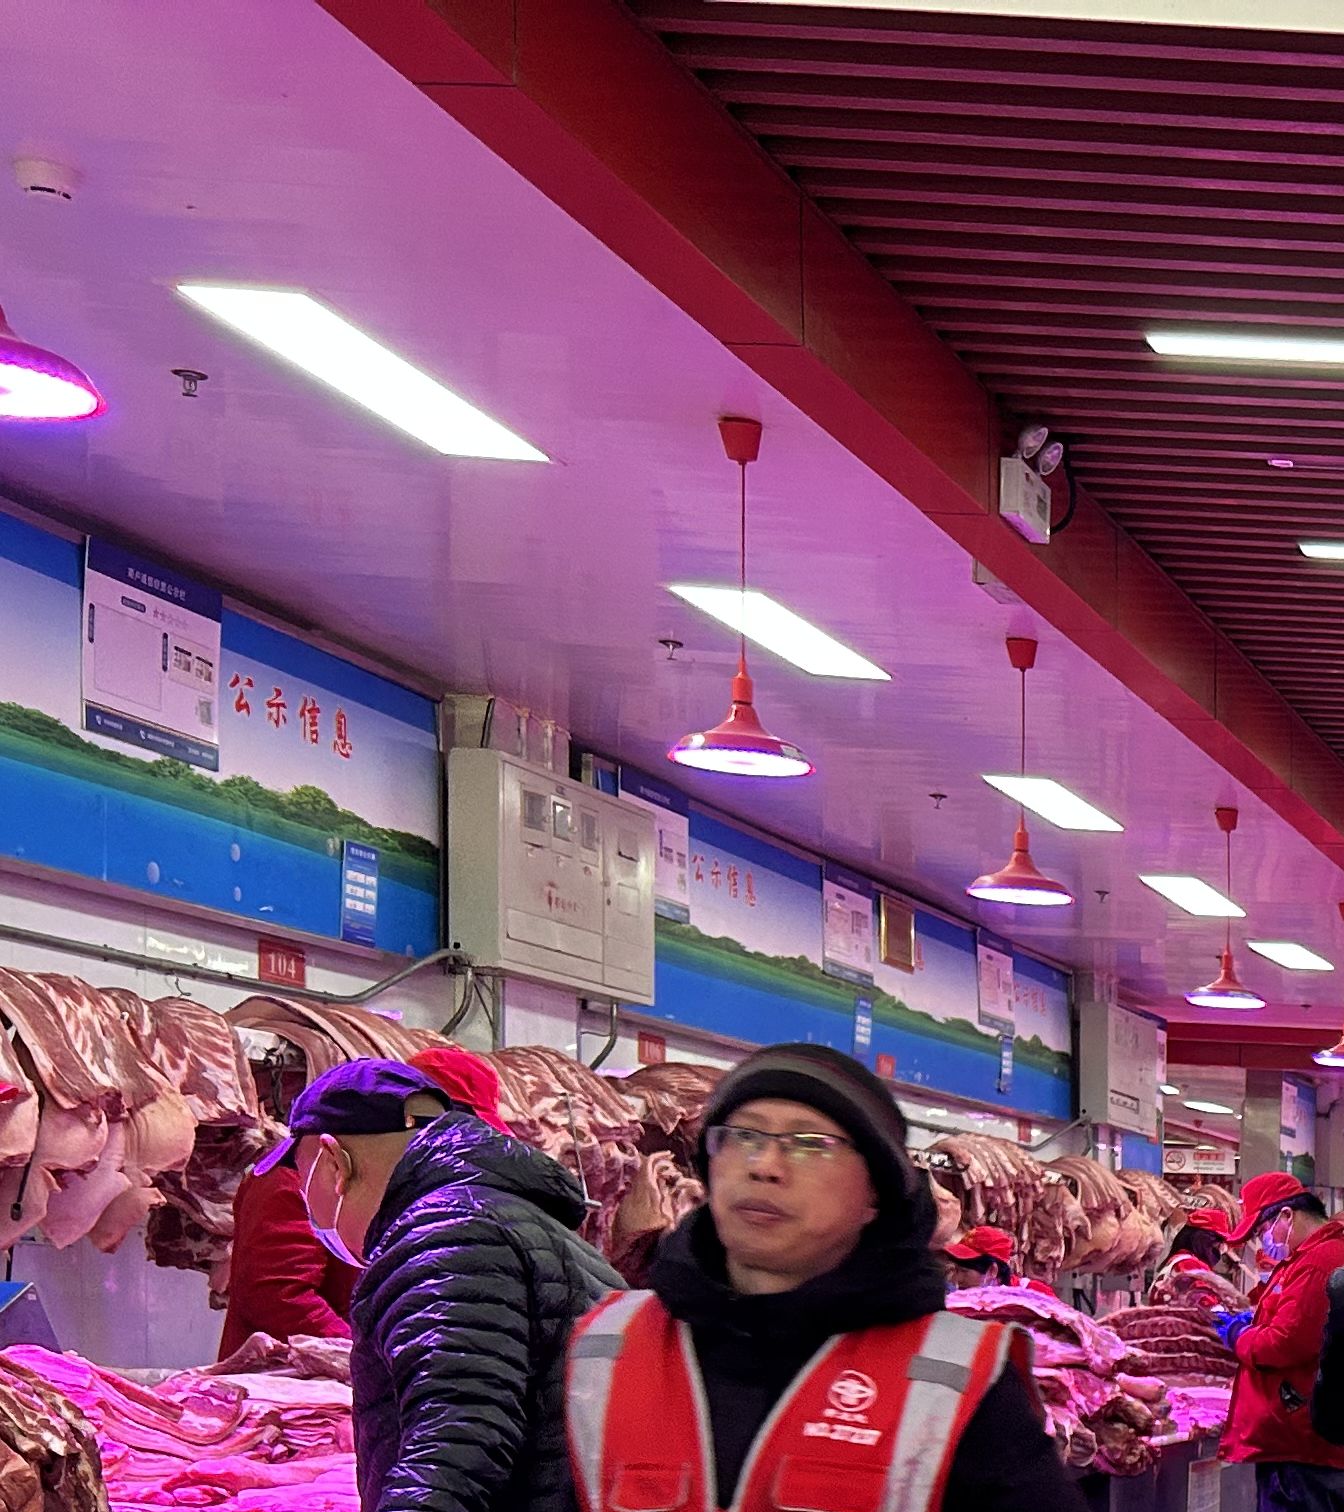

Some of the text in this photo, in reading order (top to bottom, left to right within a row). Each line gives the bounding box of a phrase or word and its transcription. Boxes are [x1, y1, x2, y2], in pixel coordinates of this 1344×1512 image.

[228, 672, 353, 759] 公示信息
[692, 854, 757, 907] 公示信息
[268, 952, 297, 979] 104
